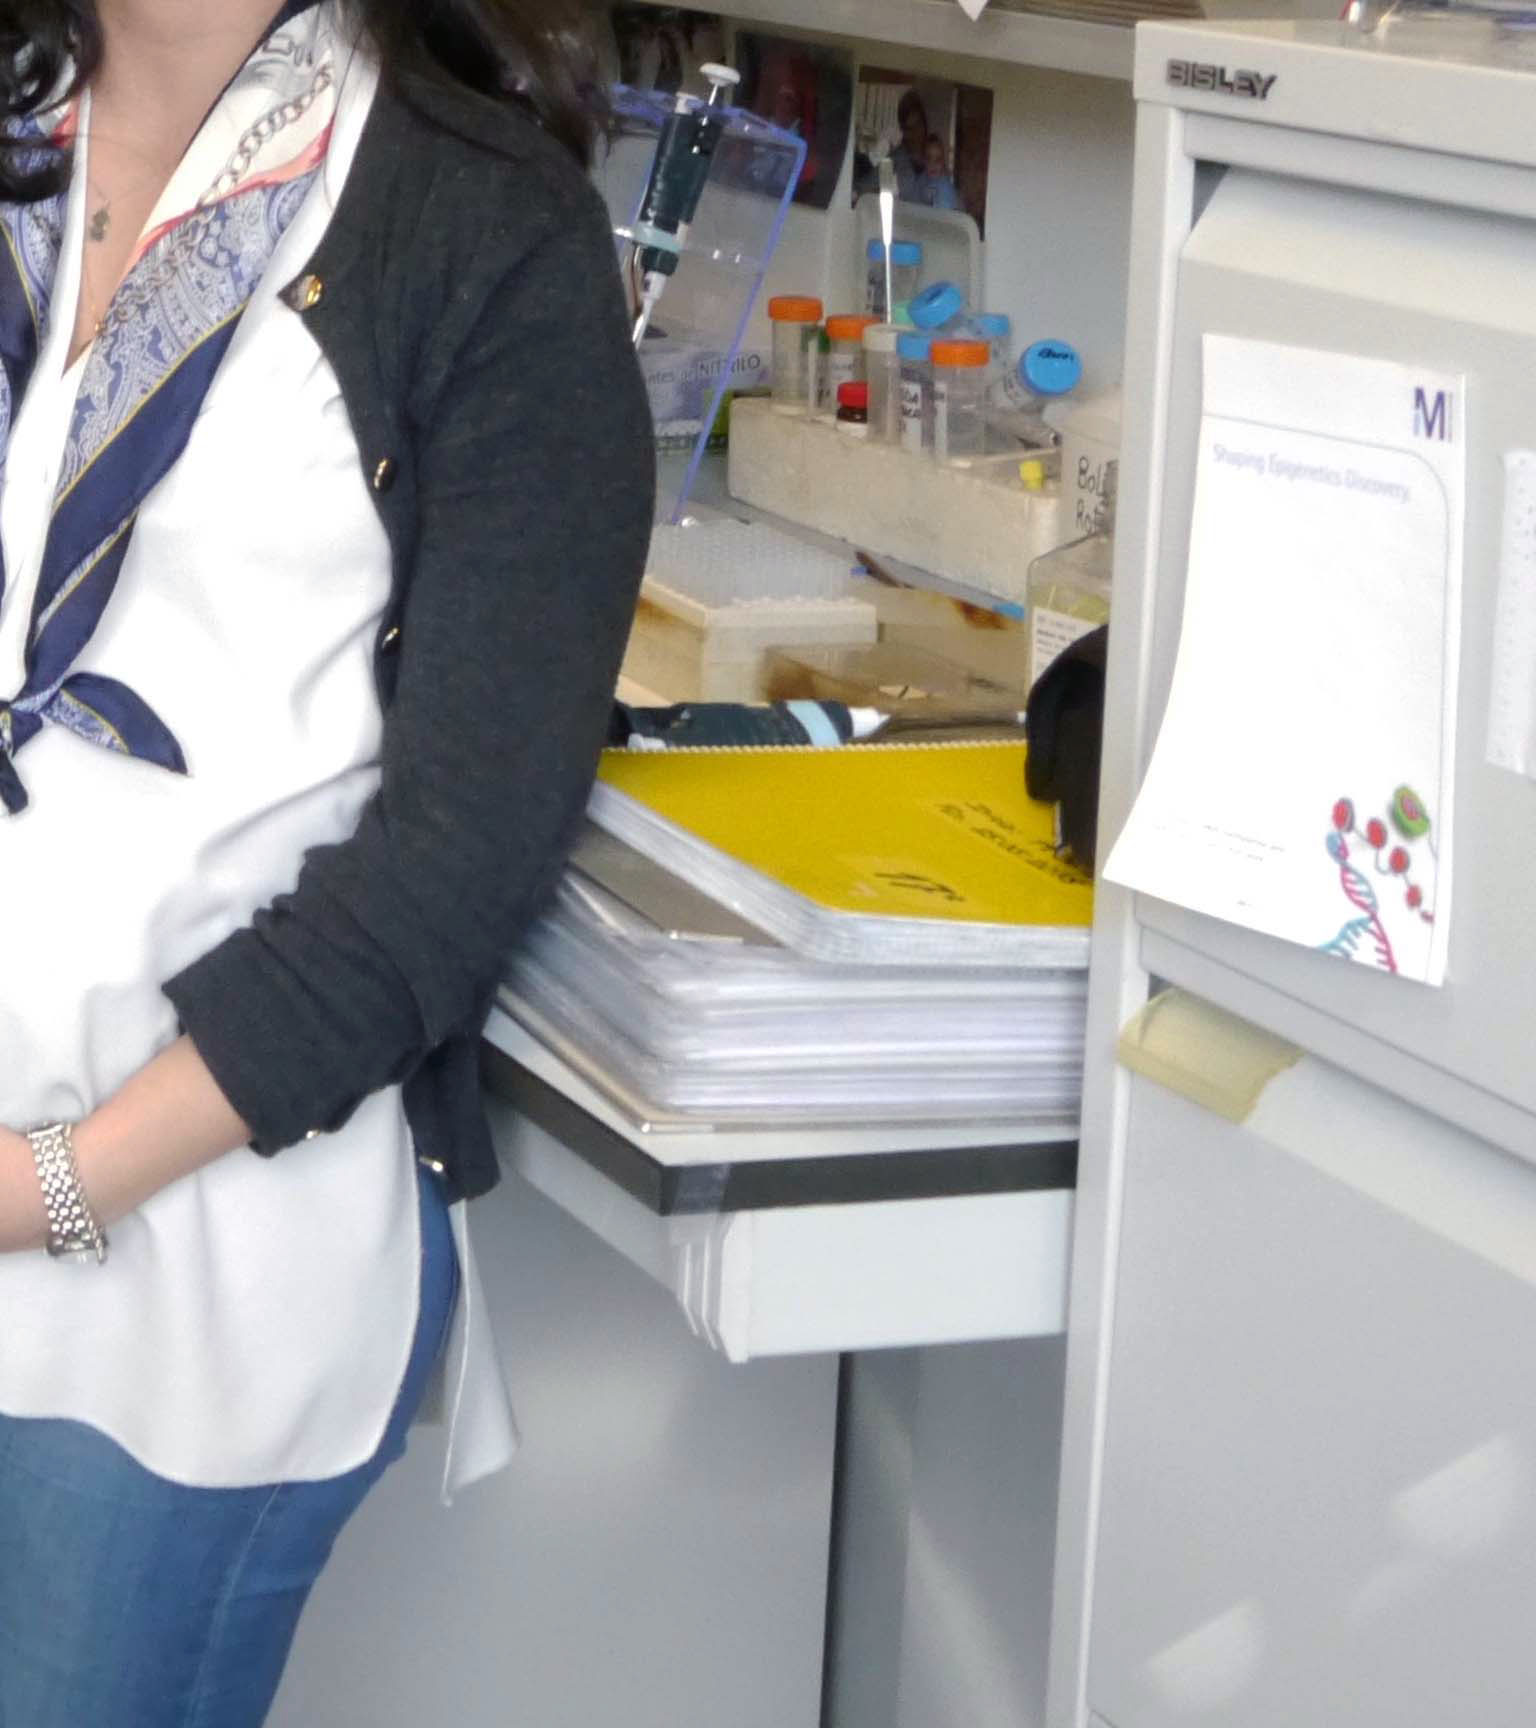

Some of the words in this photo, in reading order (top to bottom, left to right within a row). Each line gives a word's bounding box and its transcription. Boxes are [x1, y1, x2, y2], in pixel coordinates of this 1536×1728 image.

[1166, 58, 1278, 101] BISLEY
[1413, 386, 1446, 441] M
[1268, 452, 1342, 486] Epigenetics
